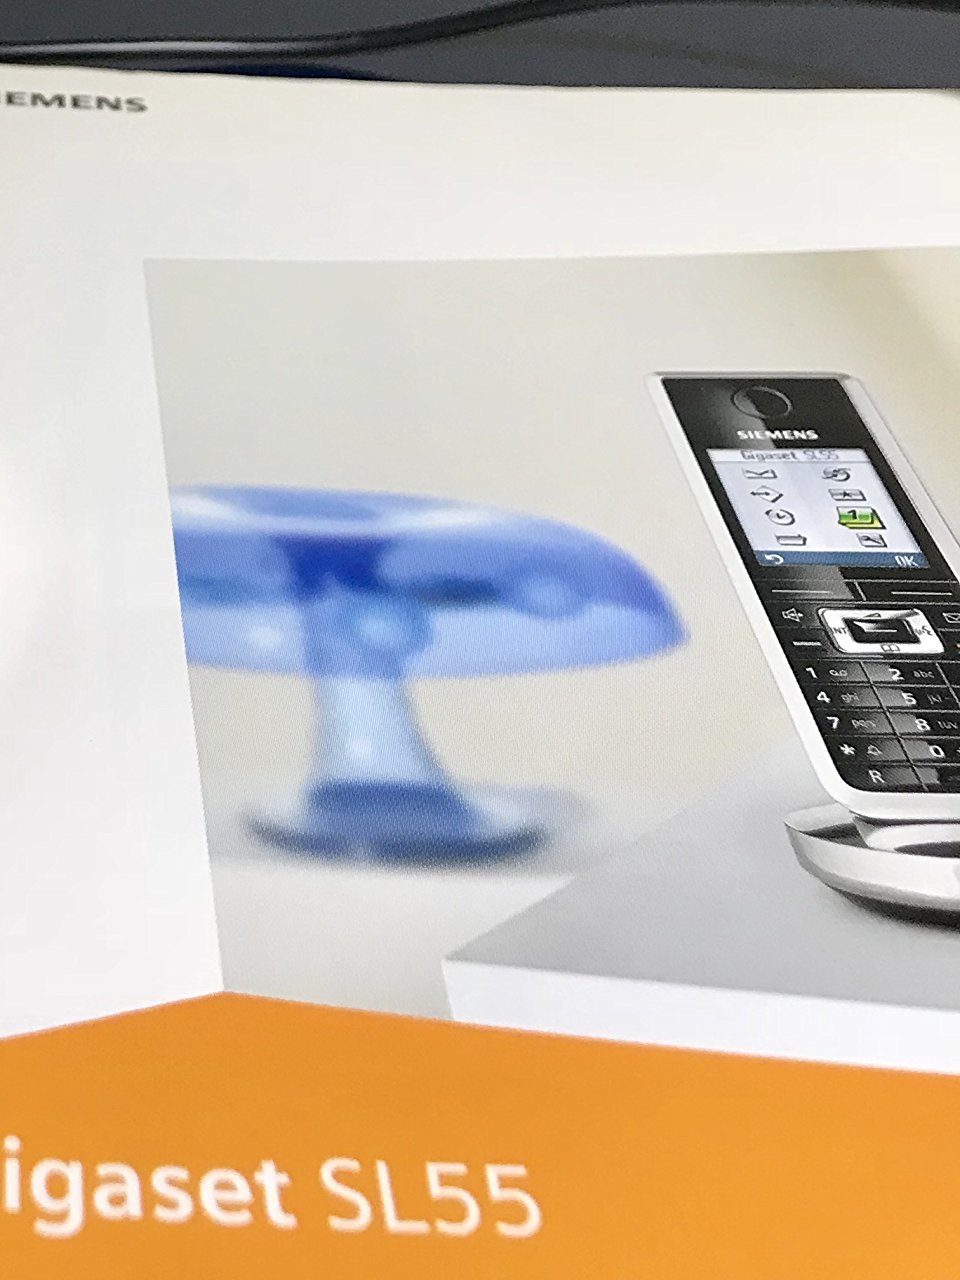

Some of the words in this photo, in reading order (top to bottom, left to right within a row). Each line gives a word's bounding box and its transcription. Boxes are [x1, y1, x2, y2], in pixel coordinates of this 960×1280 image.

[737, 429, 819, 440] SIEMENS
[741, 449, 797, 461] Gigaset
[895, 555, 917, 567] OK
[888, 668, 905, 681] 2
[913, 669, 935, 679] abc
[817, 691, 831, 703] 4
[901, 692, 917, 705] 5
[826, 716, 839, 729] 7
[915, 718, 931, 731] 8
[868, 769, 886, 784] R
[318, 1156, 543, 1238] SL55
